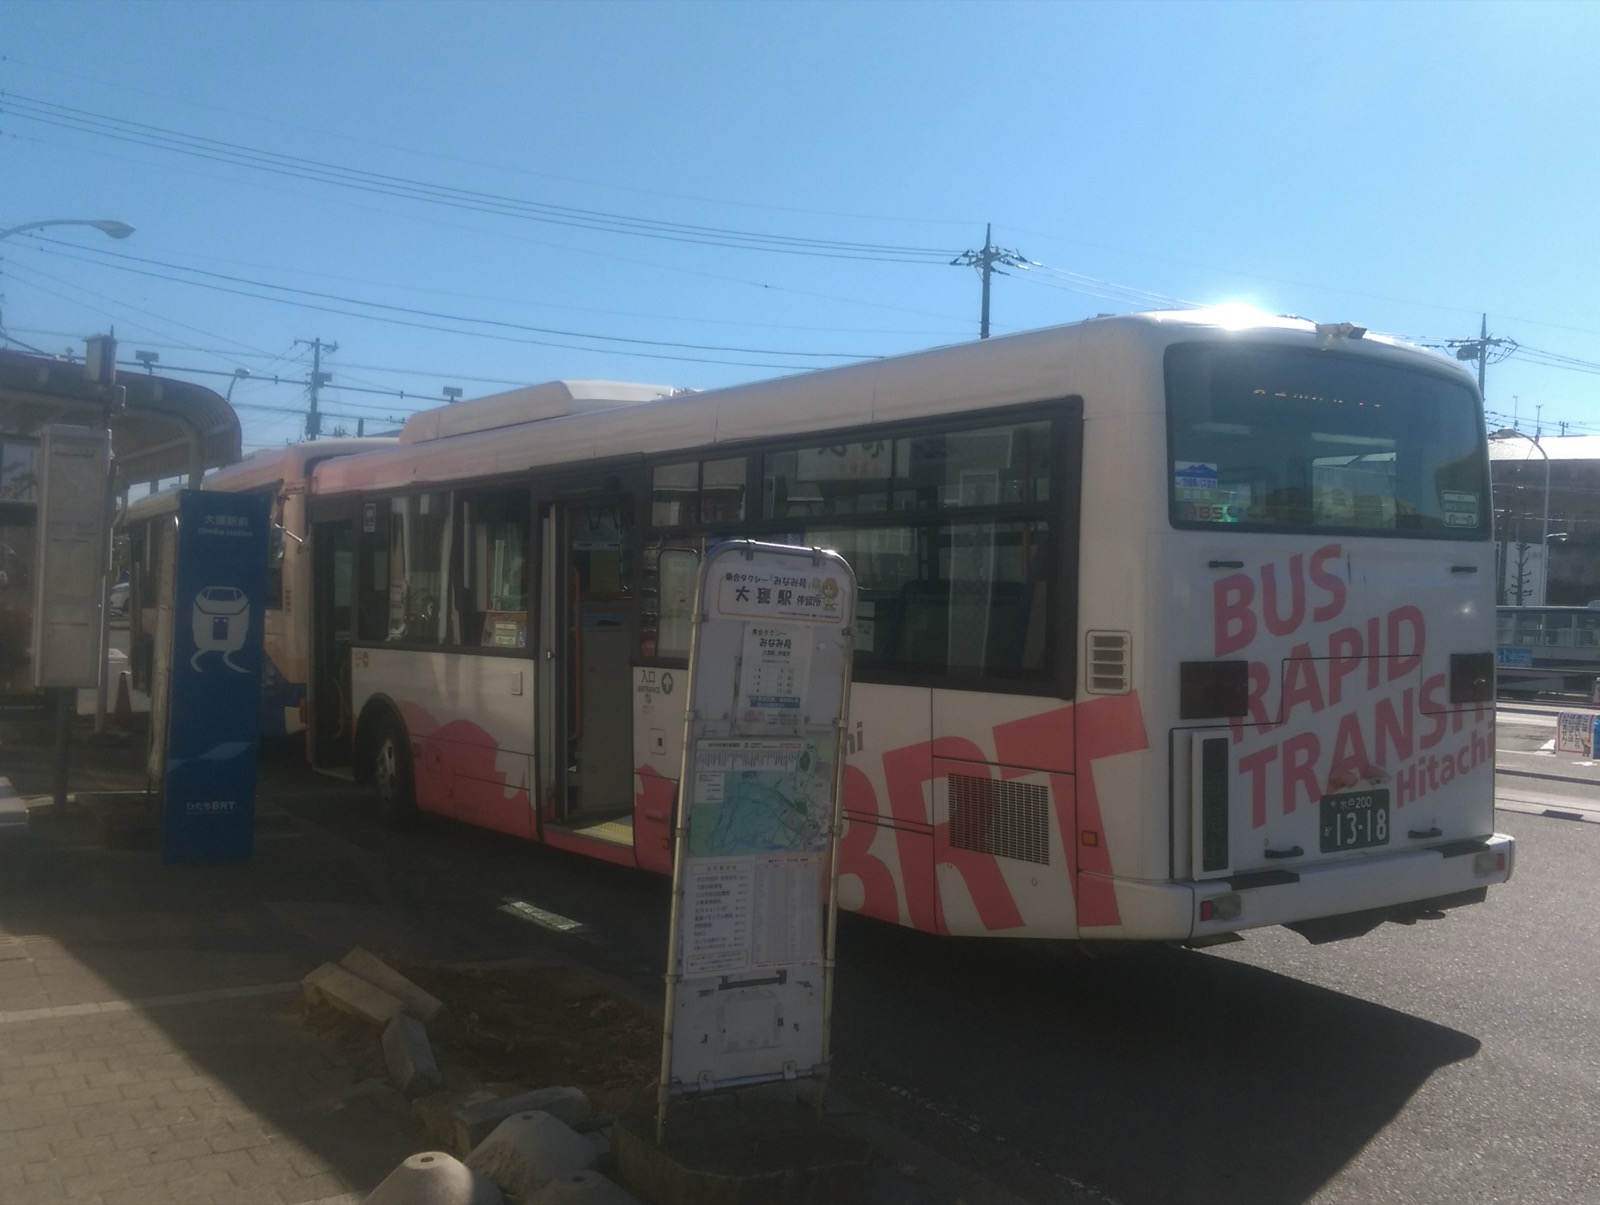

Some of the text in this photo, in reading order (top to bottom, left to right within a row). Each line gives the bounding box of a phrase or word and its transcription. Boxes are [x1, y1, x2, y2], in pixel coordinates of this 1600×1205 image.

[1213, 543, 1347, 657] BUS
[641, 669, 656, 683] 入口
[1228, 604, 1426, 745] RAPID
[1396, 718, 1495, 809] Hitachi
